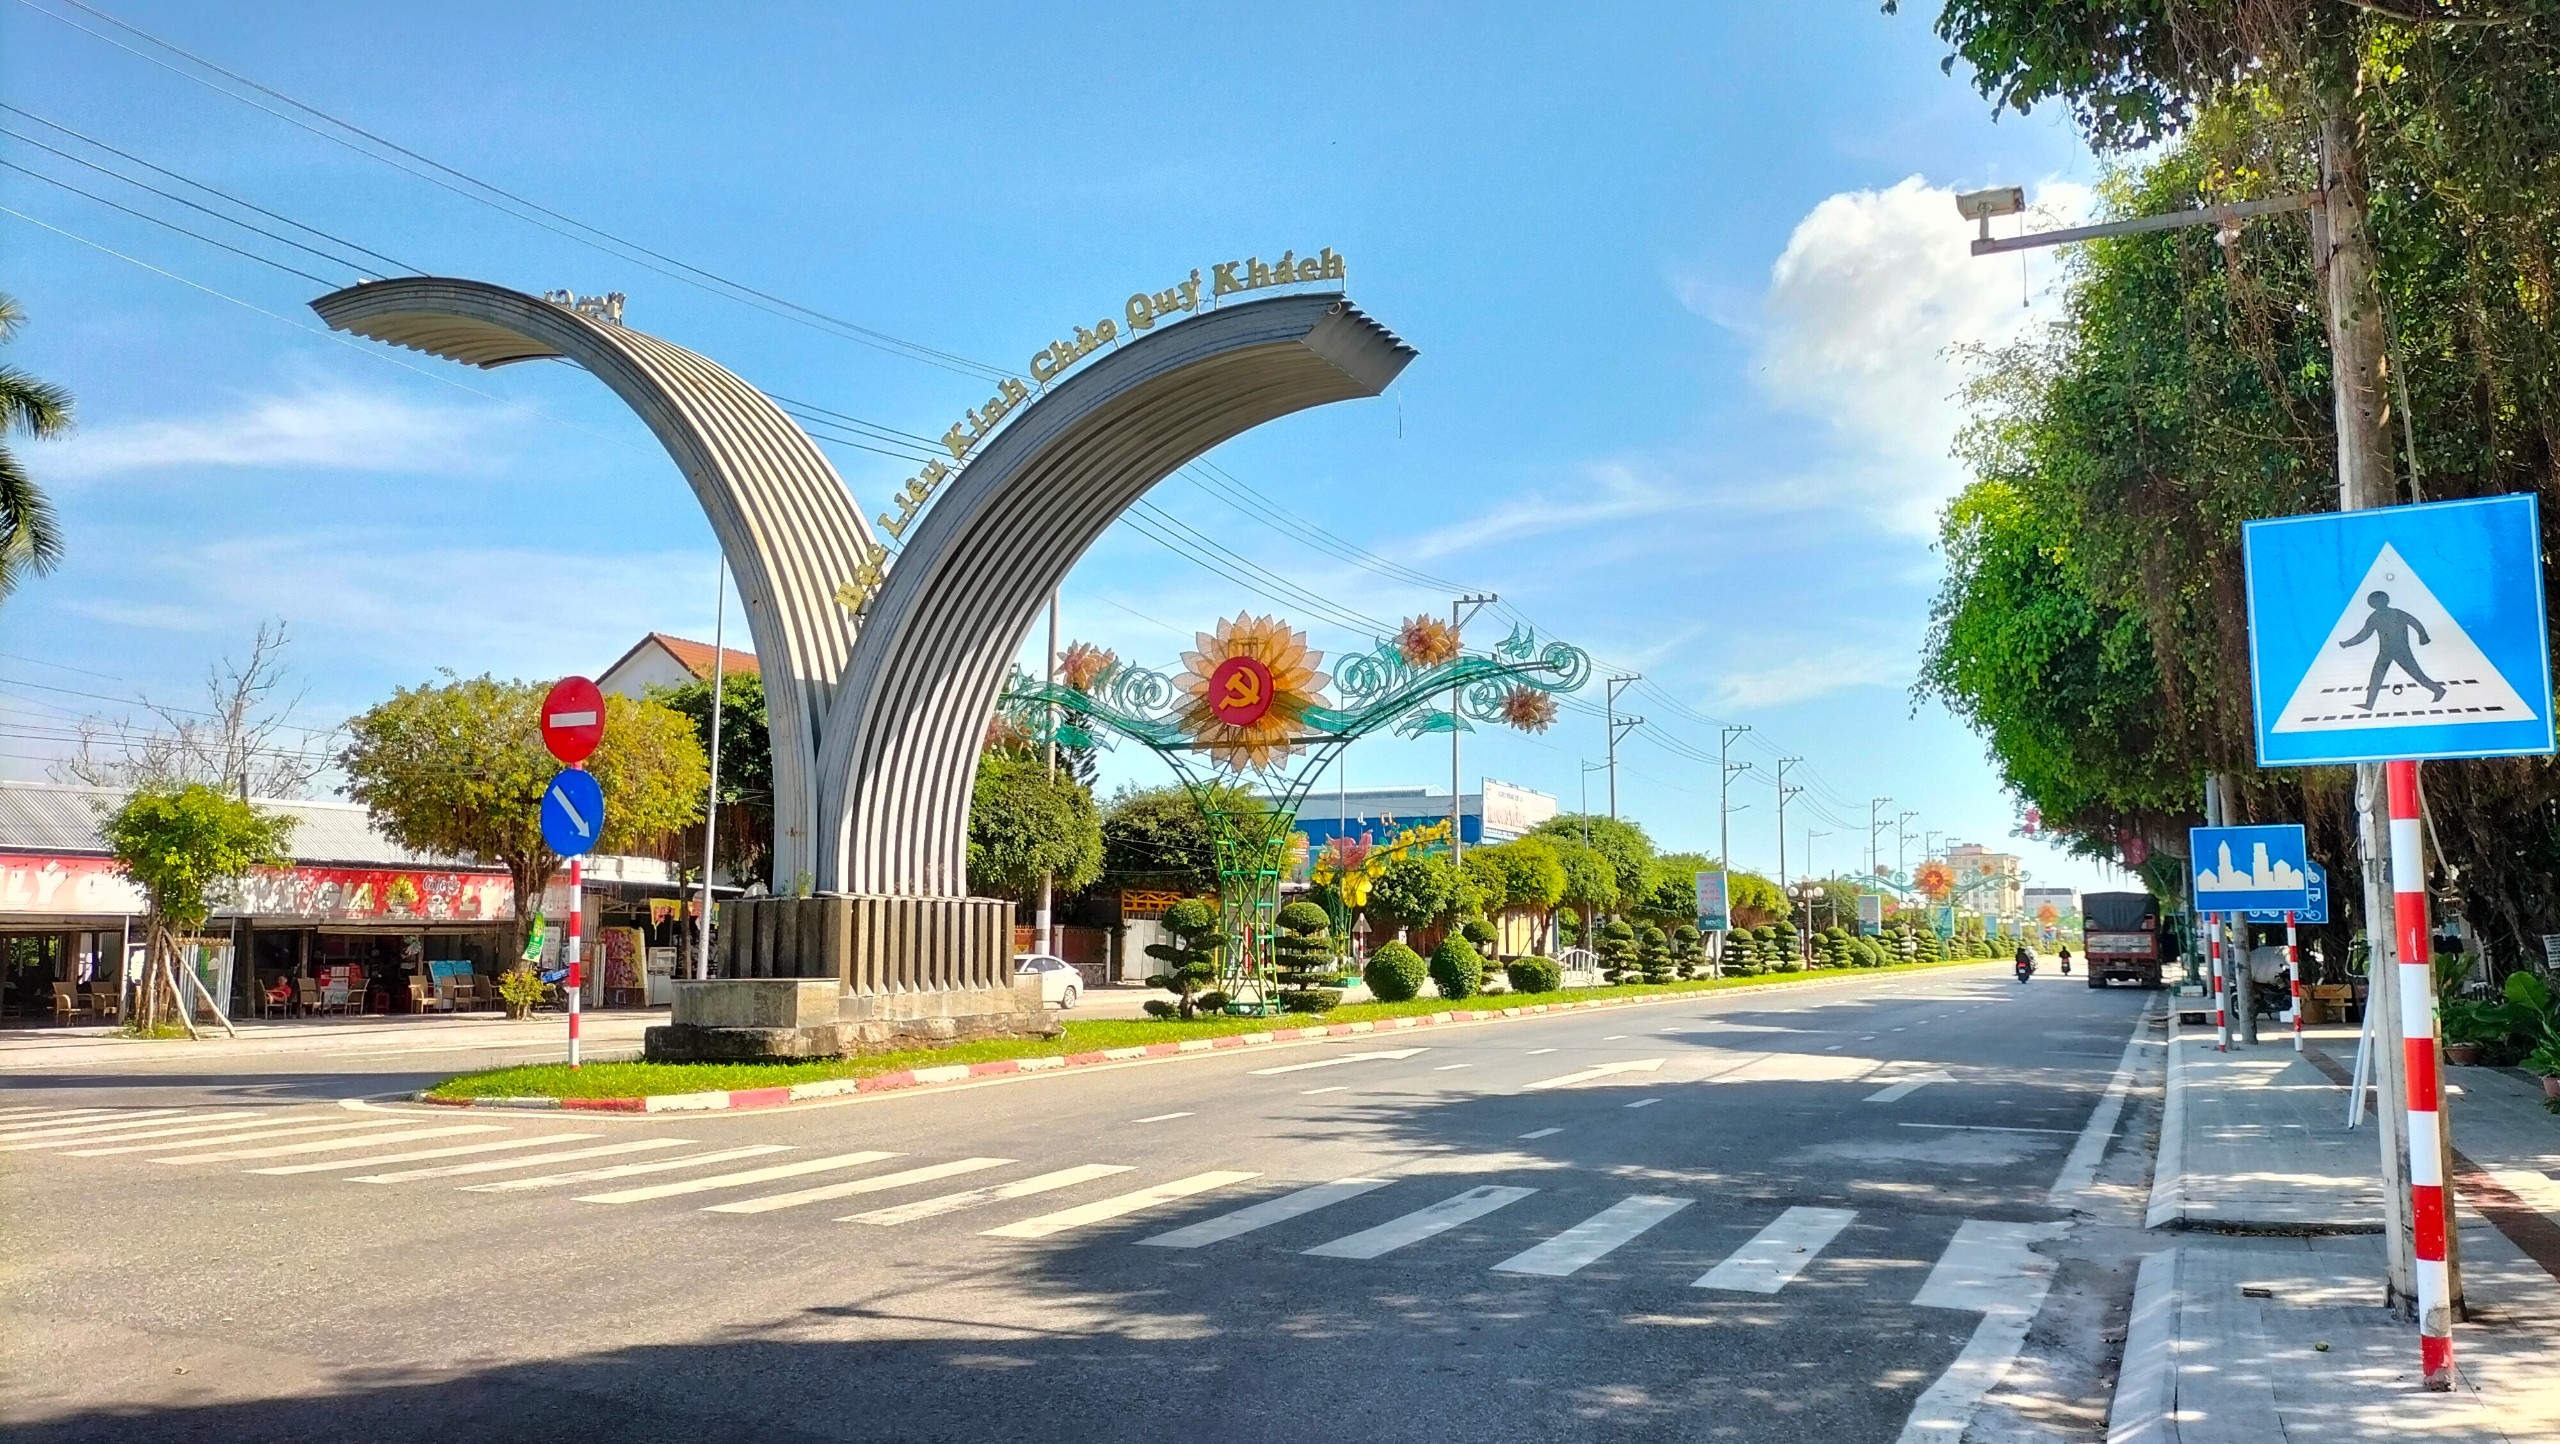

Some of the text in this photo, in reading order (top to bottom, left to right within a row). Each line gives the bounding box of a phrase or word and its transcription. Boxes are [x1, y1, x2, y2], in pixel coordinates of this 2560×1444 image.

[877, 458, 949, 540] Liêu
[1030, 318, 1119, 382] Chào
[1125, 268, 1201, 330] Quý
[1212, 246, 1345, 295] Khách
